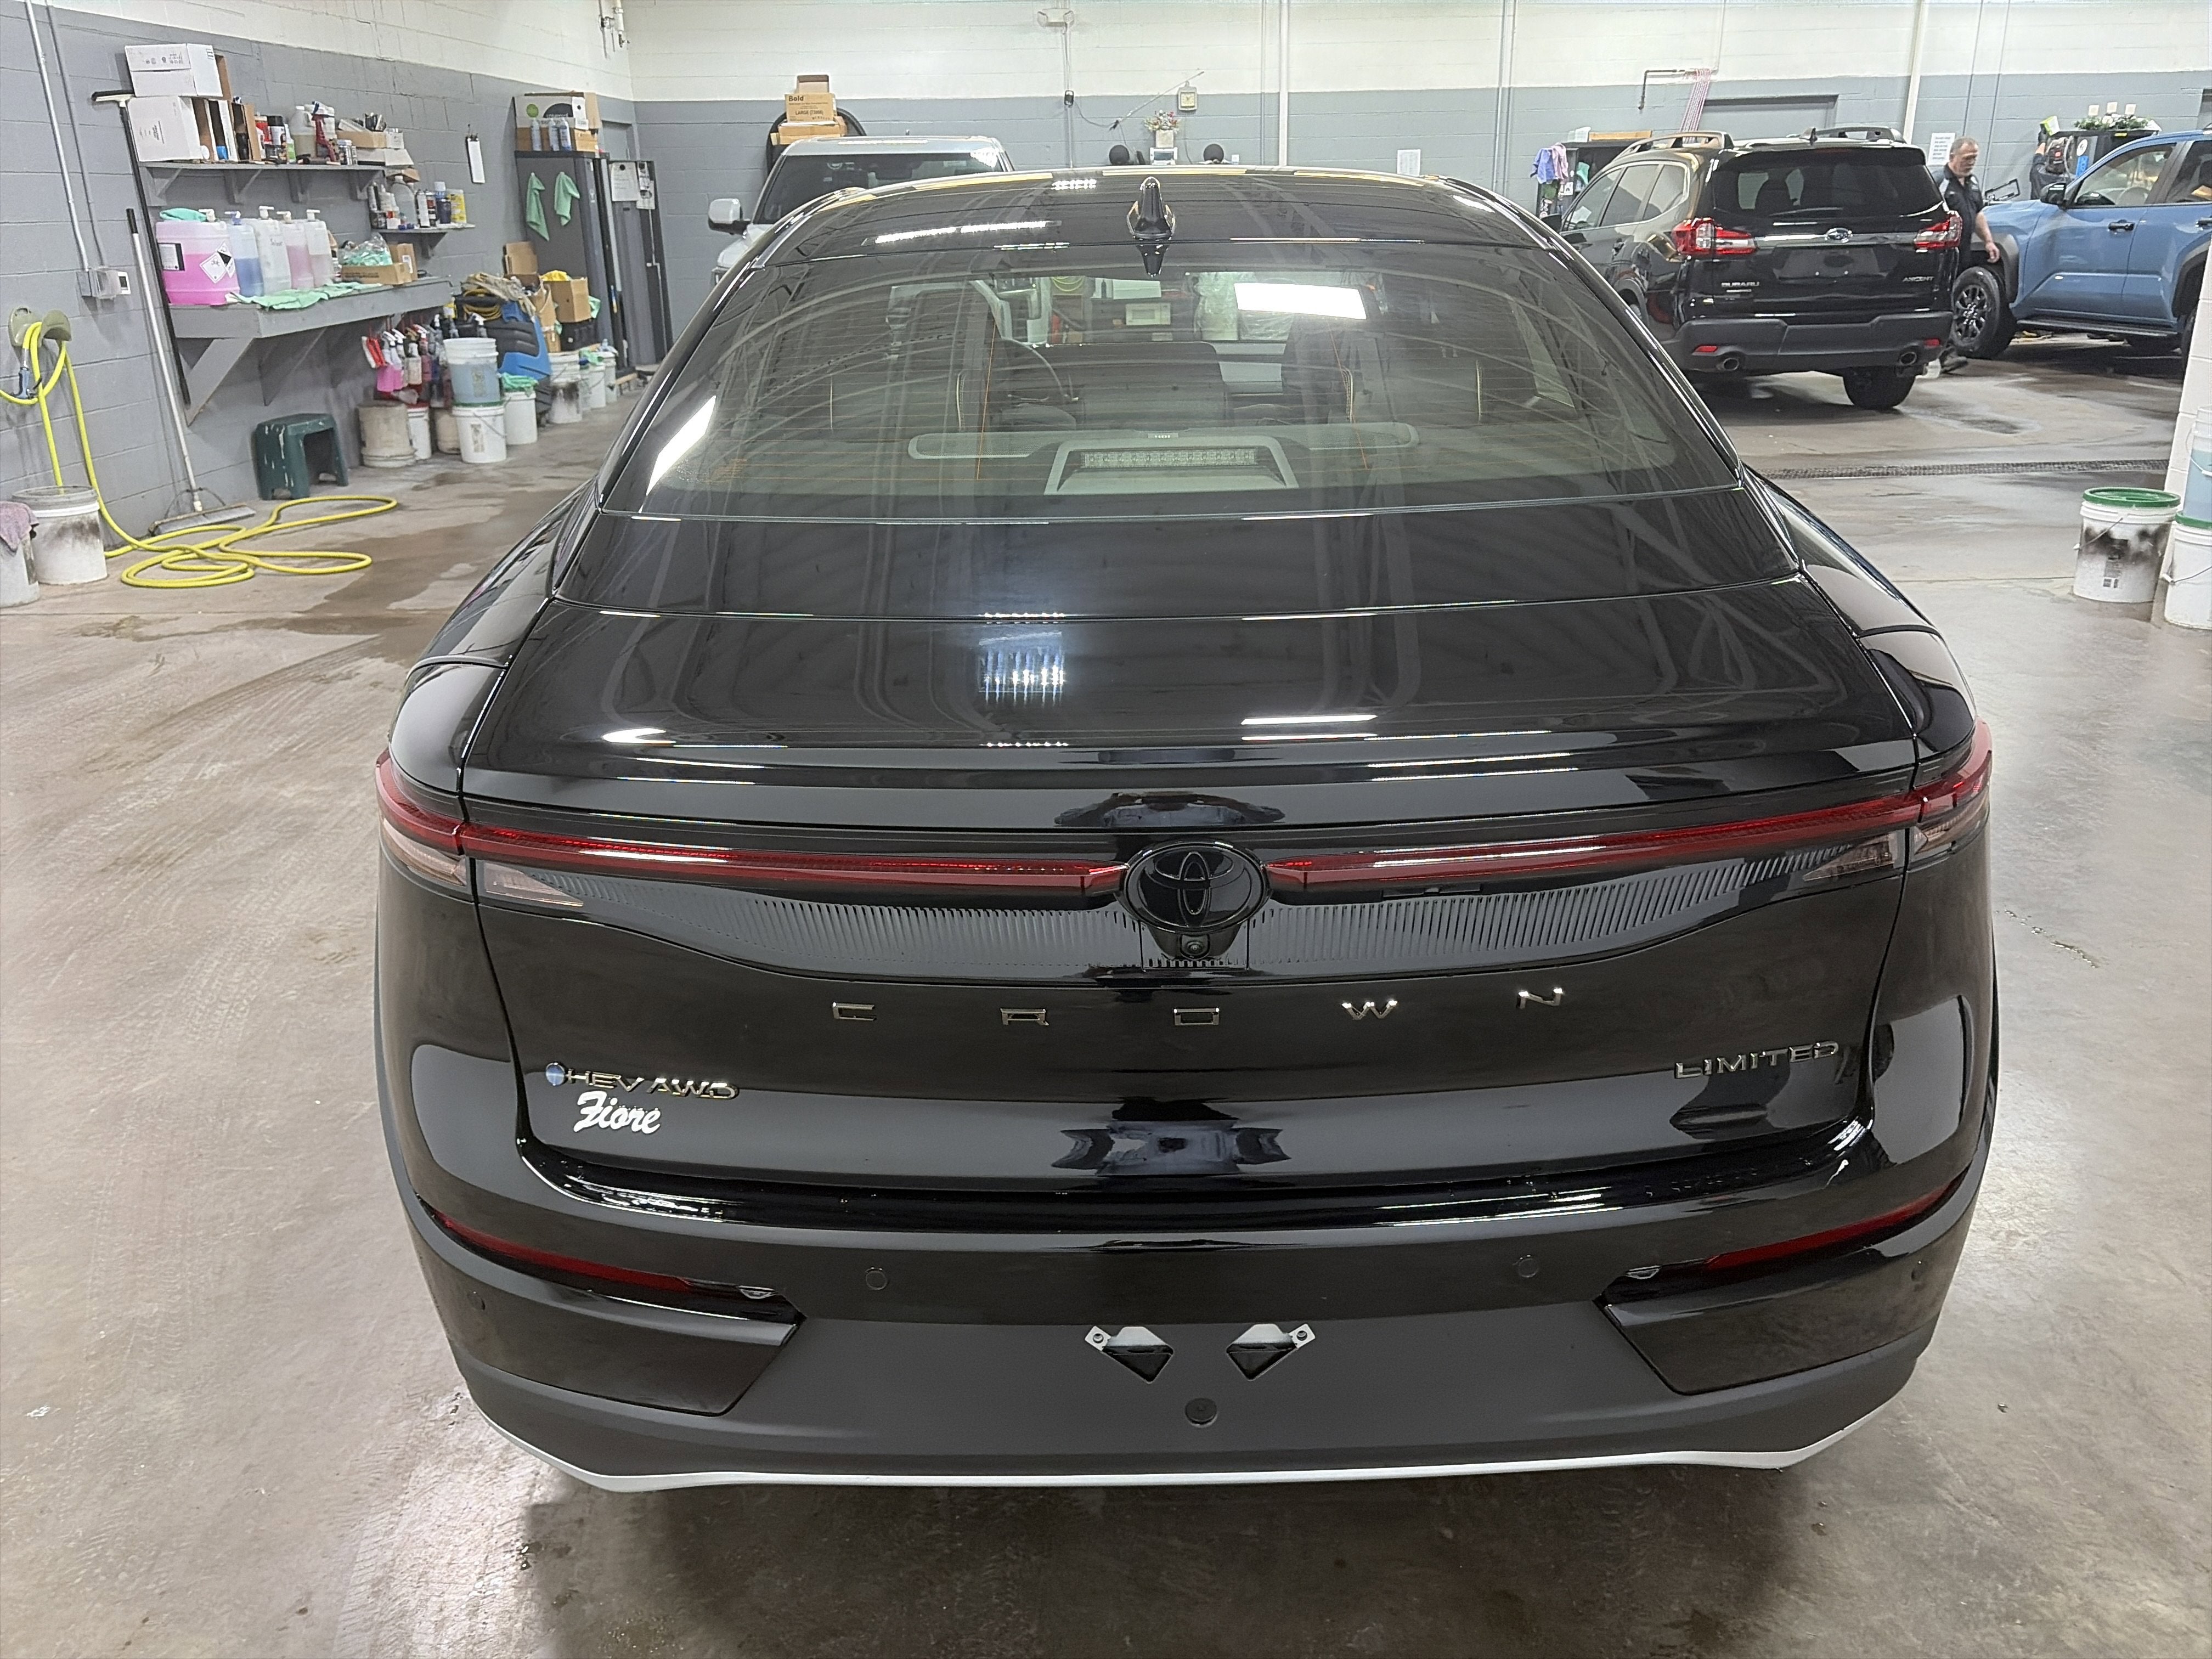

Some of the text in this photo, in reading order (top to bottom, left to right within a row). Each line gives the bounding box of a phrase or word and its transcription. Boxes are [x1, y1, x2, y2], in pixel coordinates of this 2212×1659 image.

[832, 987, 1564, 1026] CROWN
[1674, 1040, 1839, 1079] LIMITED
[566, 1068, 740, 1099] HEV AWD
[573, 1090, 662, 1134] Fiore
